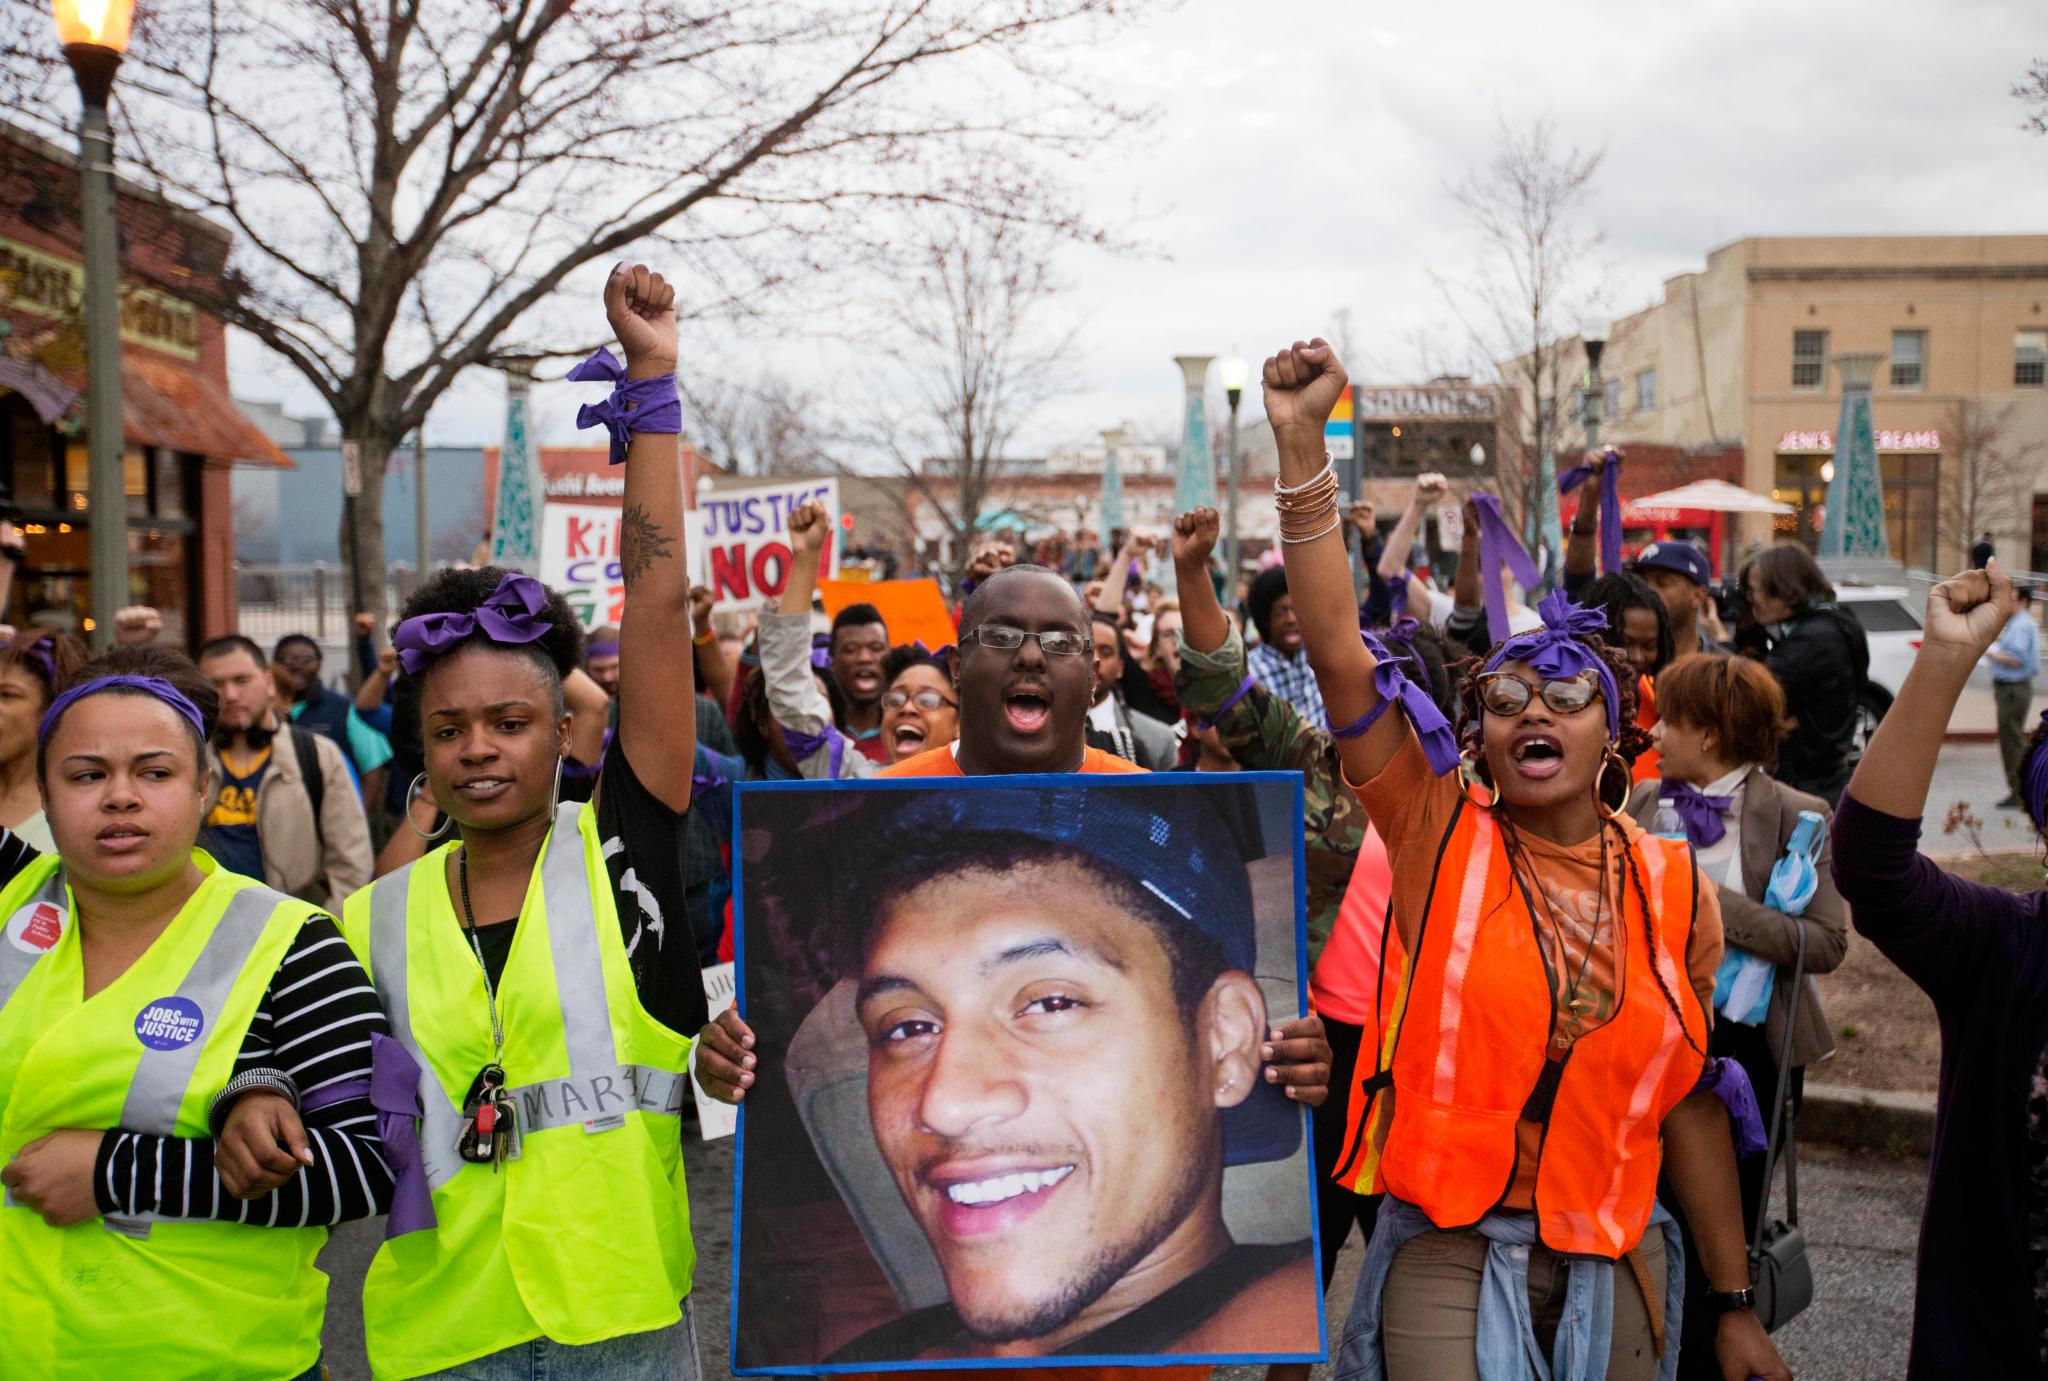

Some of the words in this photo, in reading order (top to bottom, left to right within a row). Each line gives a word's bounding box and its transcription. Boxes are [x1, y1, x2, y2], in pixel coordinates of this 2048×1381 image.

[143, 1006, 182, 1026] JOBS
[180, 1017, 200, 1028] WITH
[137, 1020, 197, 1042] JUSTICE
